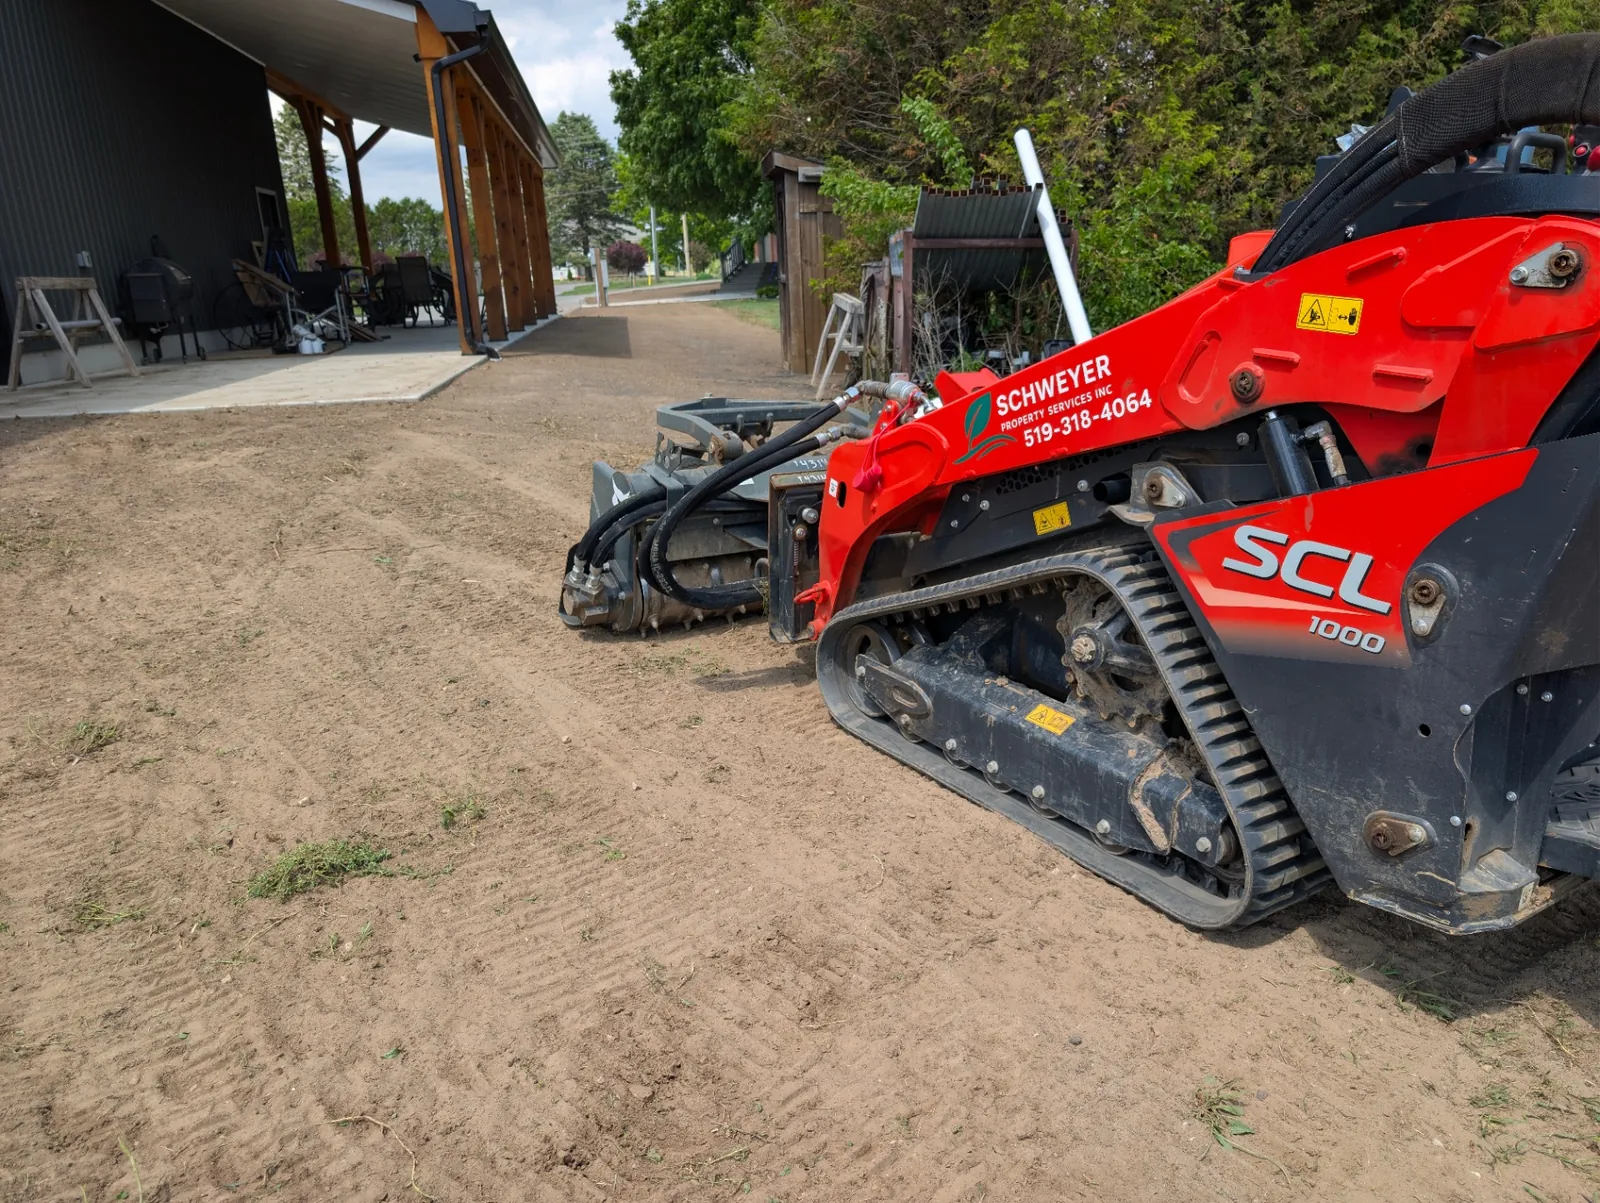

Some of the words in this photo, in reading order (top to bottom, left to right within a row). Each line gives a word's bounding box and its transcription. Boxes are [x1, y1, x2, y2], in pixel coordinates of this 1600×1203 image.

[996, 354, 1112, 417] SCHWEYER
[1000, 409, 1045, 432] PROPERTY
[1048, 392, 1093, 416] SERVICES
[1095, 384, 1113, 399] INC
[1023, 388, 1153, 448] 519-318-4064
[1221, 524, 1392, 616] SCL
[1308, 615, 1386, 653] 1000
